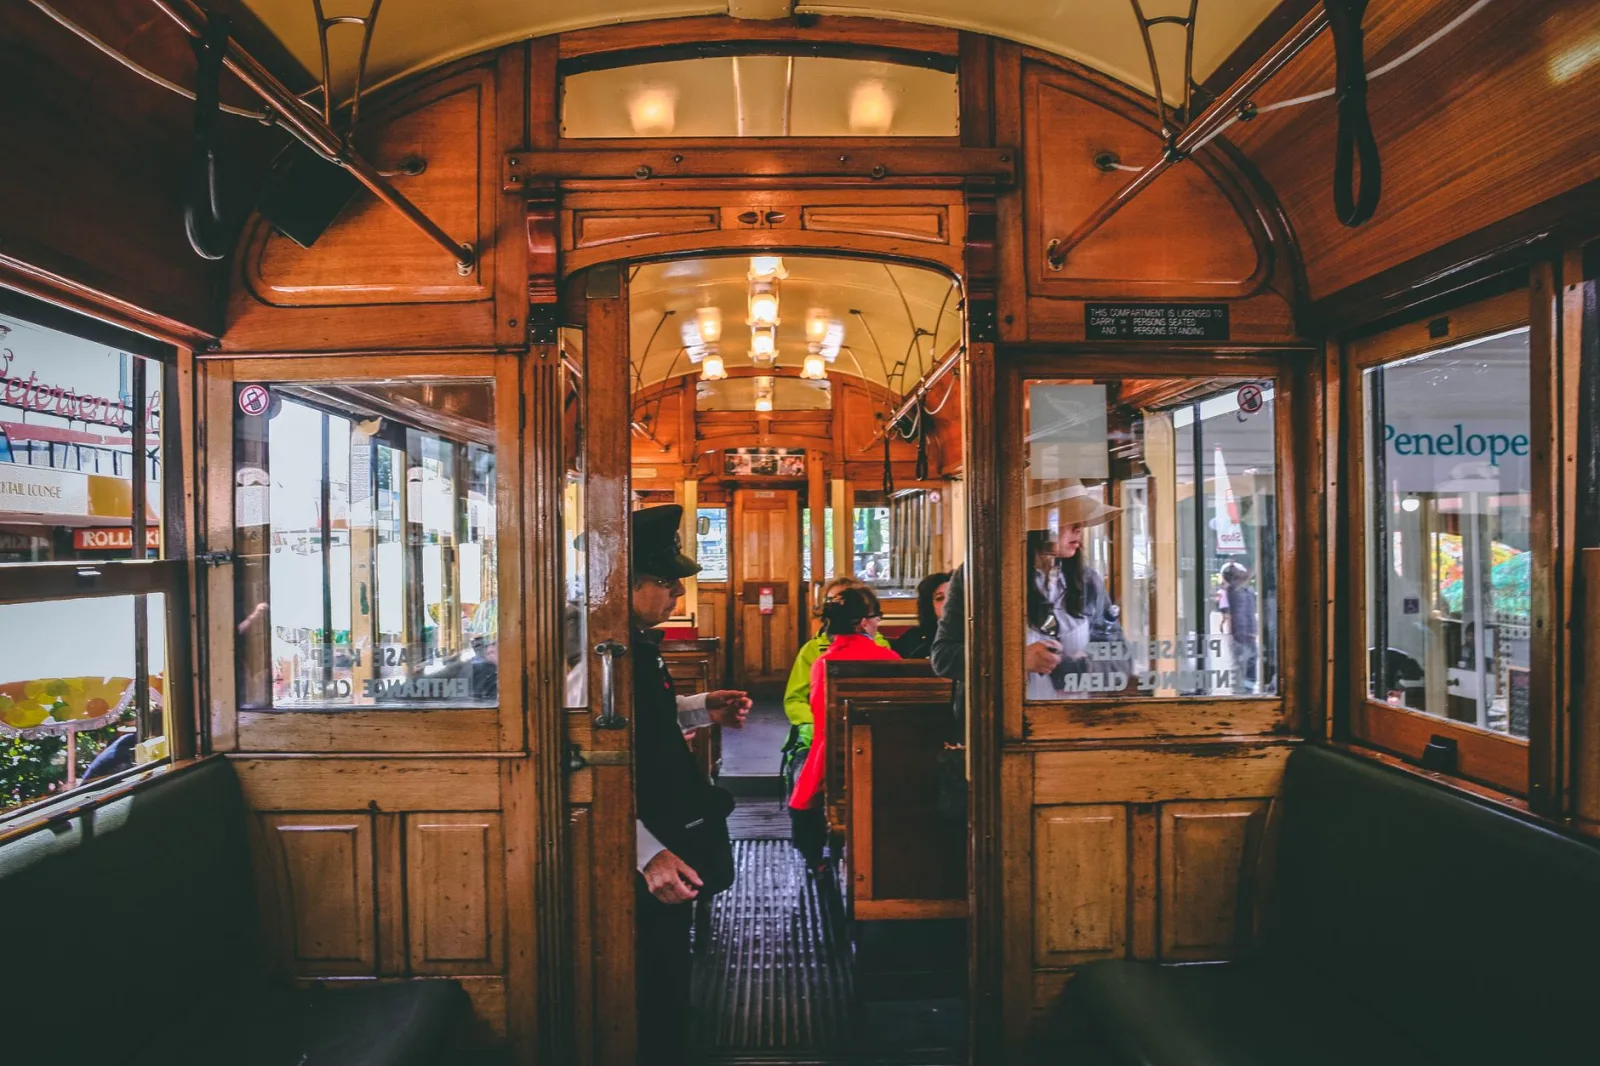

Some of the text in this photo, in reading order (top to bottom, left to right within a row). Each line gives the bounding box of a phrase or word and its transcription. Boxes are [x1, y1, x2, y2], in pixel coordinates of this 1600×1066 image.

[1091, 308, 1223, 318] THIS COMPARTMENT IS LICENSED TO
[1091, 317, 1115, 326] CARRY
[1133, 317, 1166, 326] PERSONS
[1168, 318, 1196, 327] SEATED
[1102, 326, 1117, 335] AND
[1133, 326, 1166, 335] PERSONS
[1168, 326, 1205, 336] STANDING
[0, 480, 62, 499] KTAIL LOUNGE
